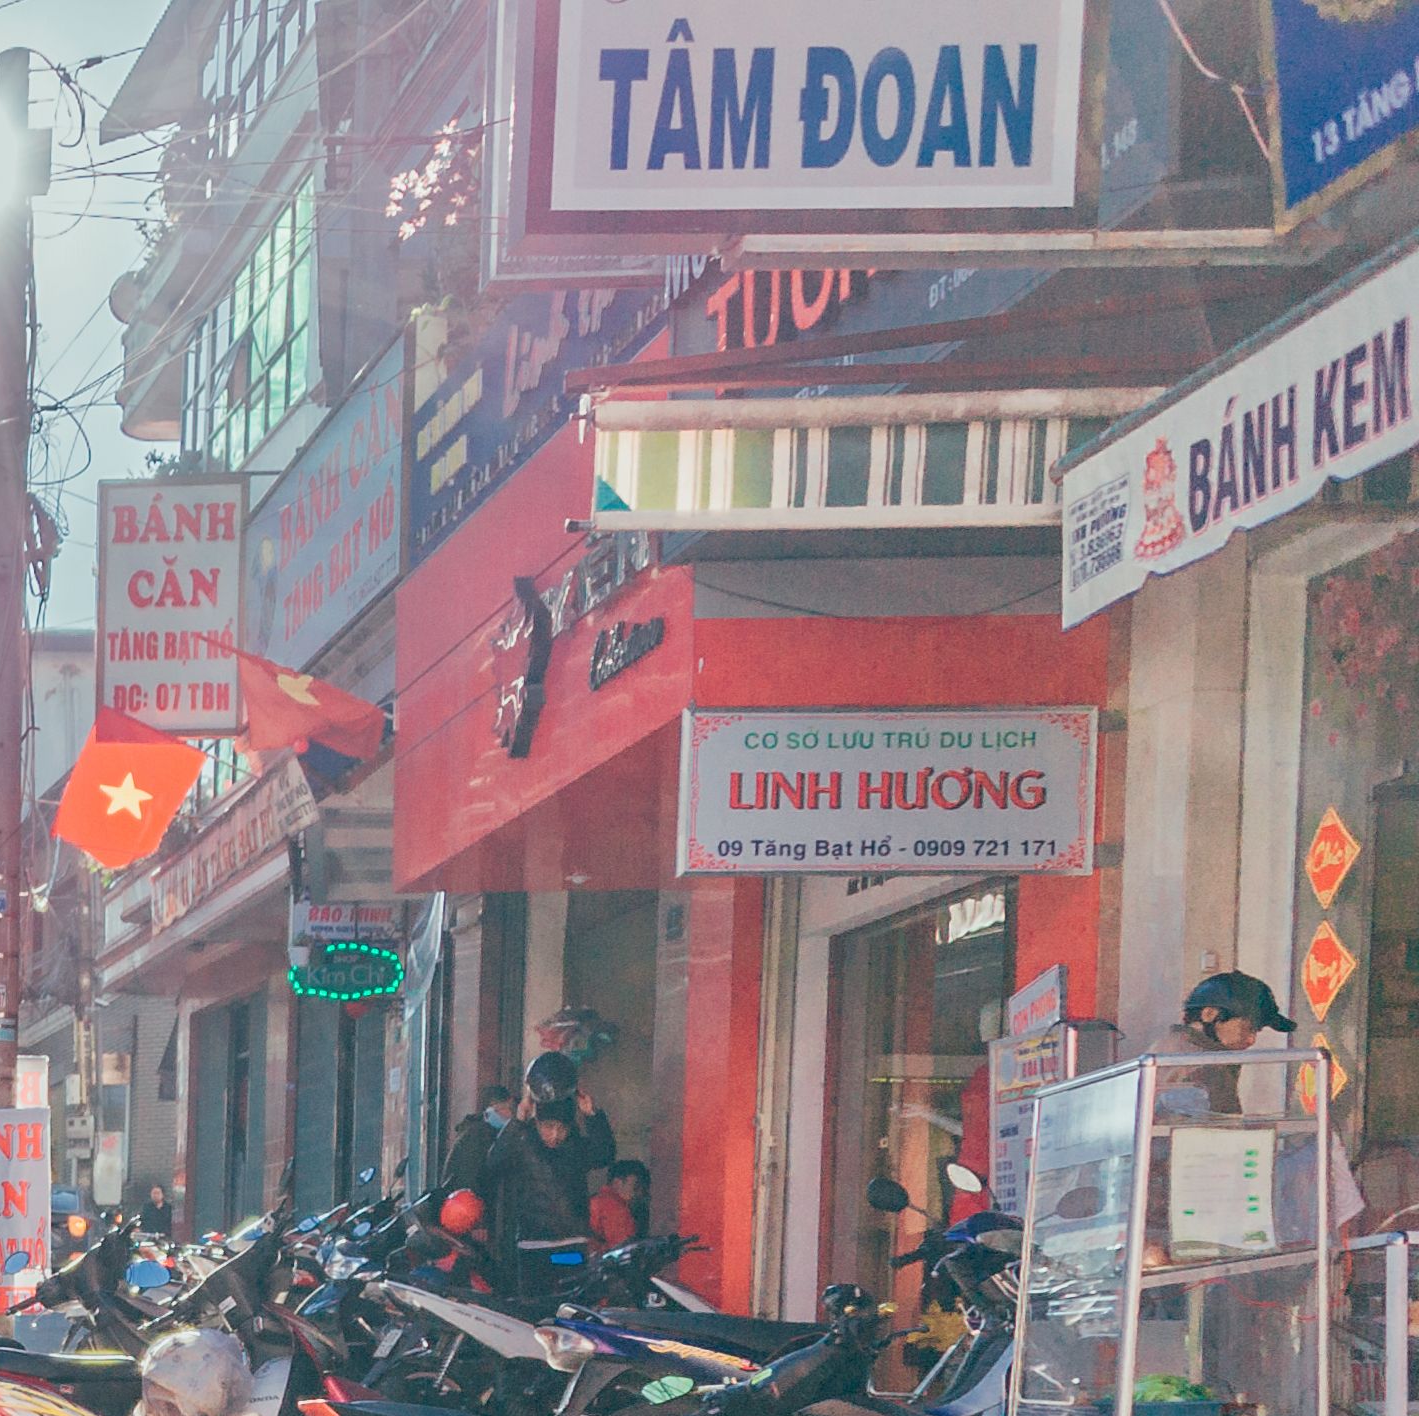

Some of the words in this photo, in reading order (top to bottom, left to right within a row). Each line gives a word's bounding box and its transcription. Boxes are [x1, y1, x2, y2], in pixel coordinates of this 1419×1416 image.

[598, 18, 775, 171] TÂM
[797, 43, 1039, 169] ĐOAN
[1188, 396, 1298, 534] BÁNH
[1313, 315, 1412, 470] KEM
[112, 492, 236, 544] BÁNH
[127, 554, 221, 608] CĂN
[107, 626, 159, 662] TĂNG
[164, 630, 204, 667] BẠT
[206, 617, 235, 661] HỔ
[155, 682, 182, 712] 07
[188, 682, 230, 711] TBH
[744, 730, 779, 750] CƠ
[787, 727, 819, 750] SỞ
[827, 731, 875, 750] LƯU
[883, 727, 930, 750] TRÚ
[940, 731, 973, 749] DU
[981, 731, 1037, 752] LỊCH
[728, 770, 842, 811] LINH
[857, 766, 1048, 811] HƯƠNG
[718, 840, 743, 858] 09
[750, 839, 806, 861] Tăng
[815, 840, 853, 861] Bạt
[860, 835, 892, 858] Hổ
[914, 840, 965, 858] 0909
[973, 840, 1009, 857] 721
[1020, 839, 1057, 857] 171
